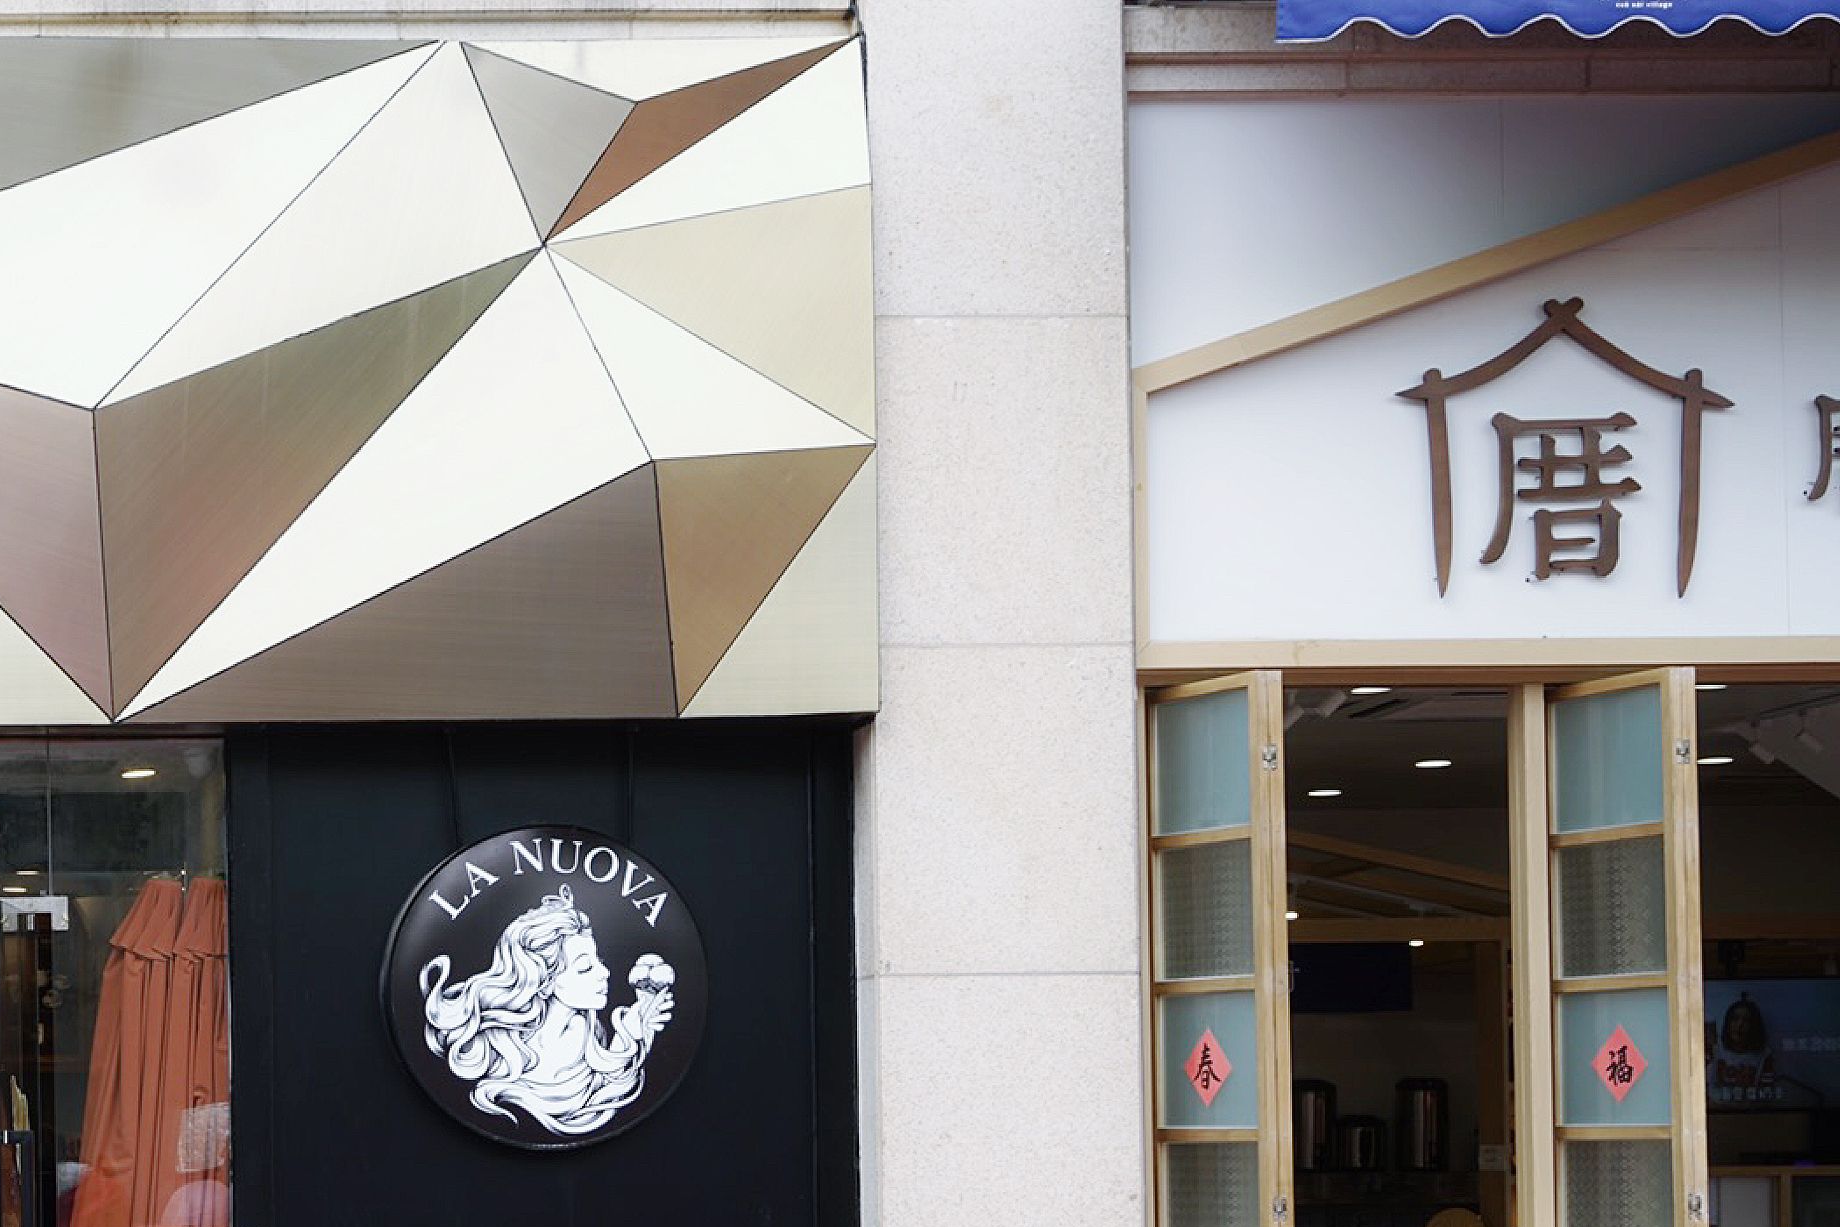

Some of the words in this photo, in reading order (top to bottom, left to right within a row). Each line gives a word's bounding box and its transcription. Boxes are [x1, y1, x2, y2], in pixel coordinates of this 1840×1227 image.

[428, 860, 500, 921] LA
[509, 837, 669, 928] NUOVA
[1193, 1041, 1223, 1090] 春
[1606, 1045, 1635, 1087] 福
